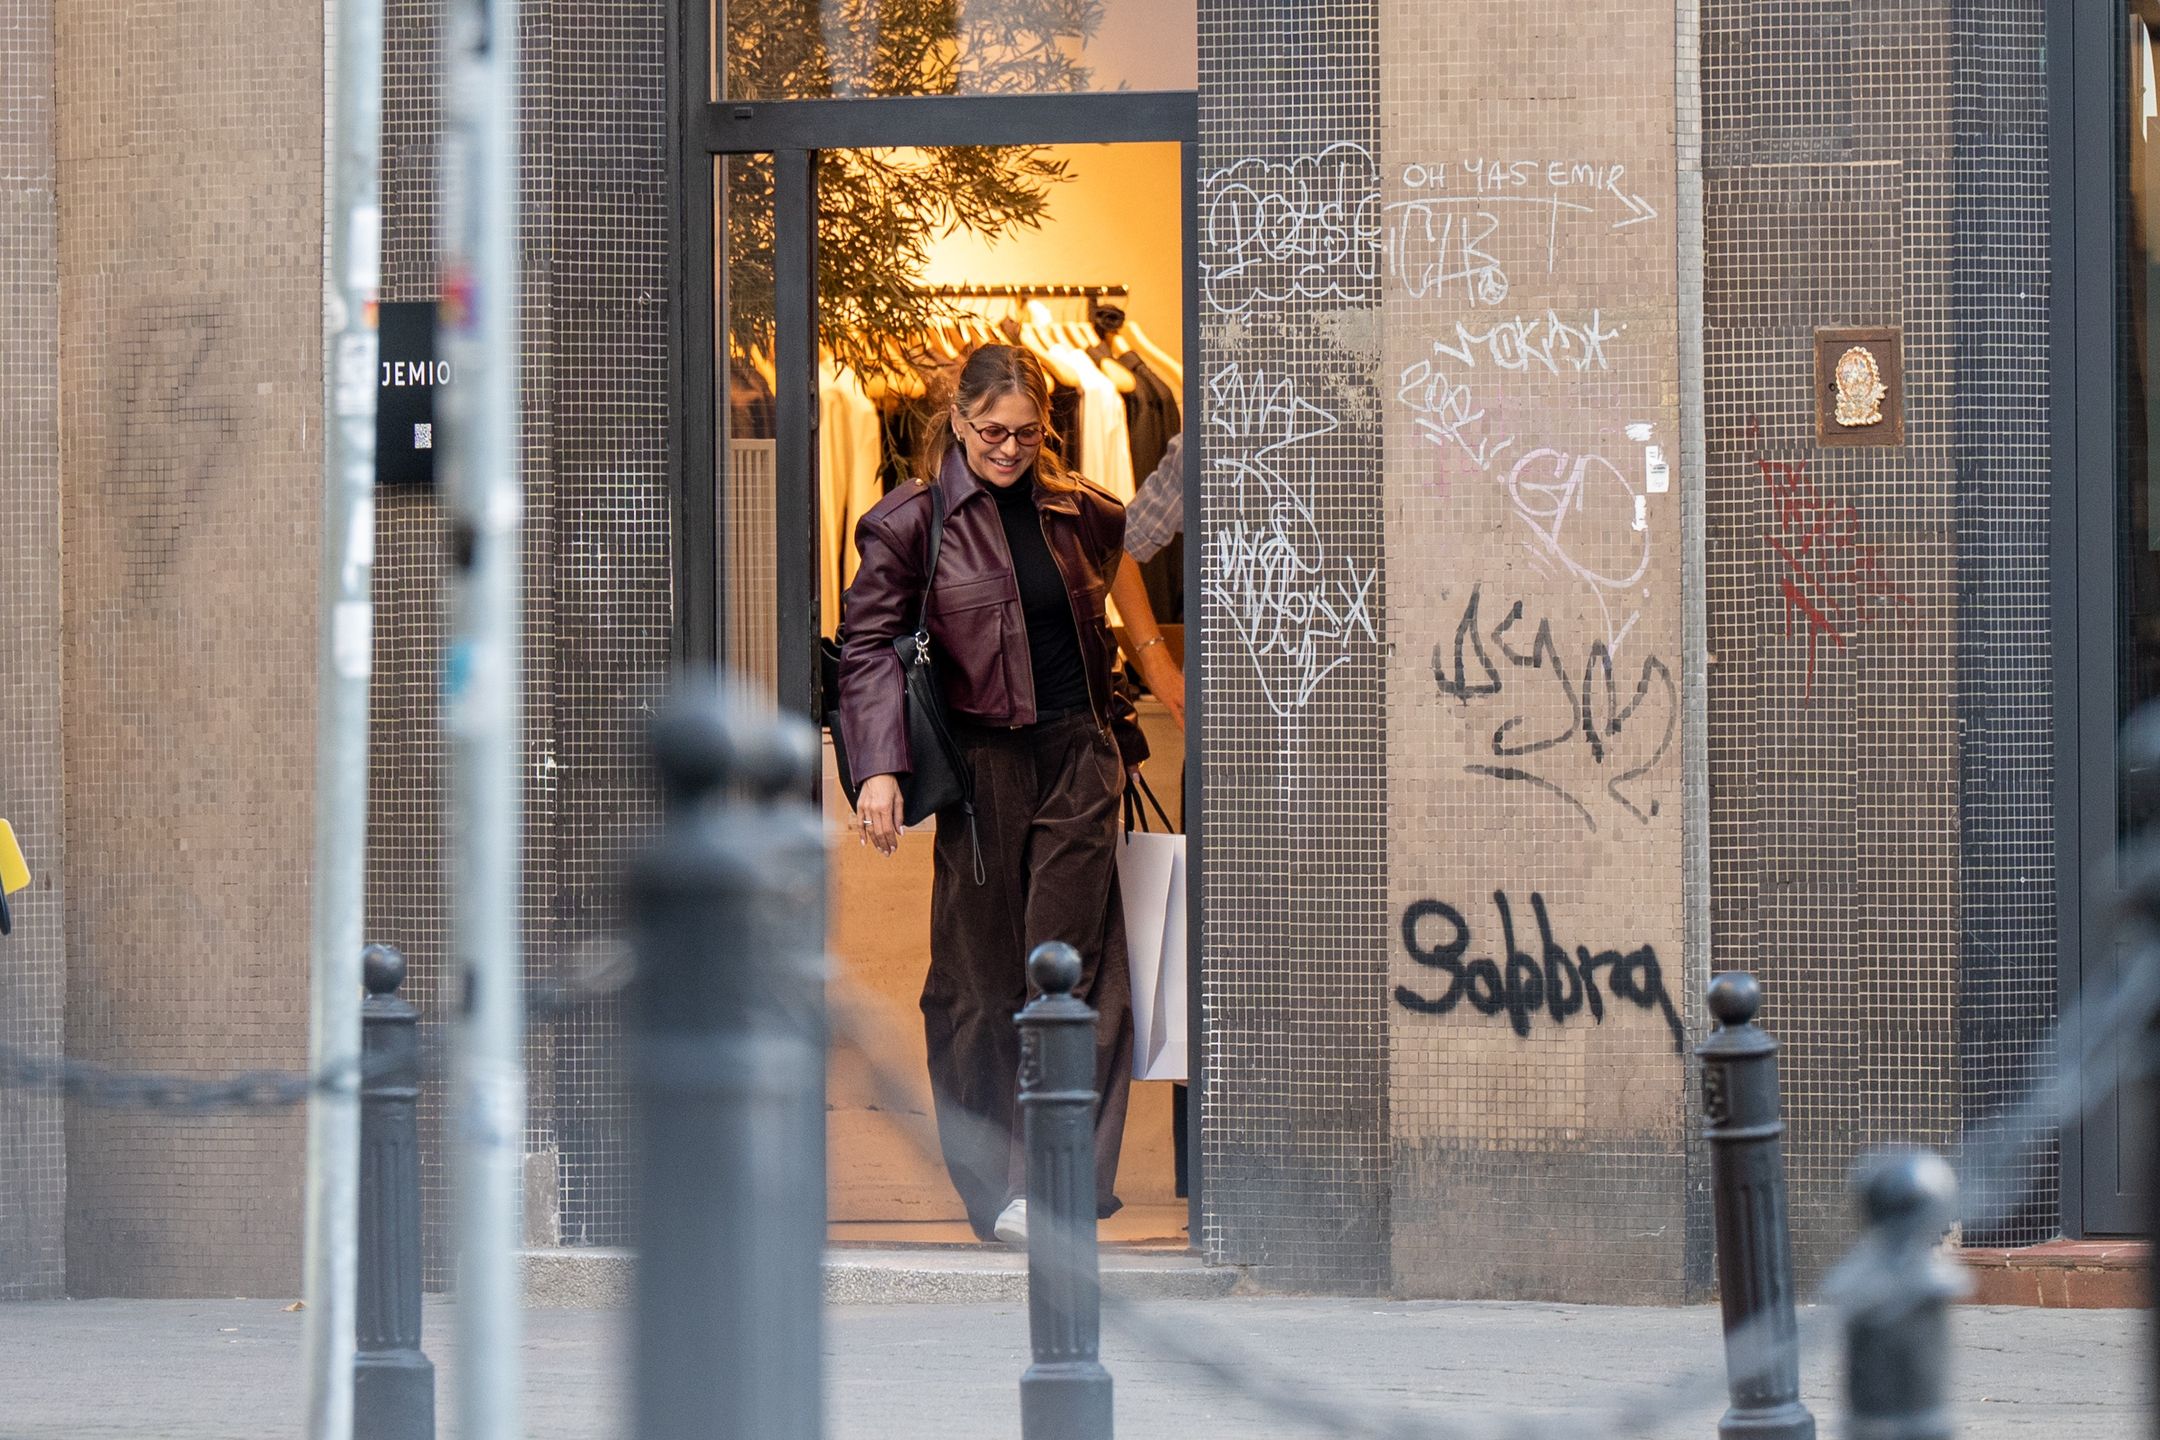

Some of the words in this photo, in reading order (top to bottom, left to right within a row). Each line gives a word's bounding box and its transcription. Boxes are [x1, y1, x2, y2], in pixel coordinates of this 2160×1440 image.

[1402, 164, 1445, 189] OH
[1464, 156, 1538, 192] YAS
[1548, 160, 1630, 196] EMIR
